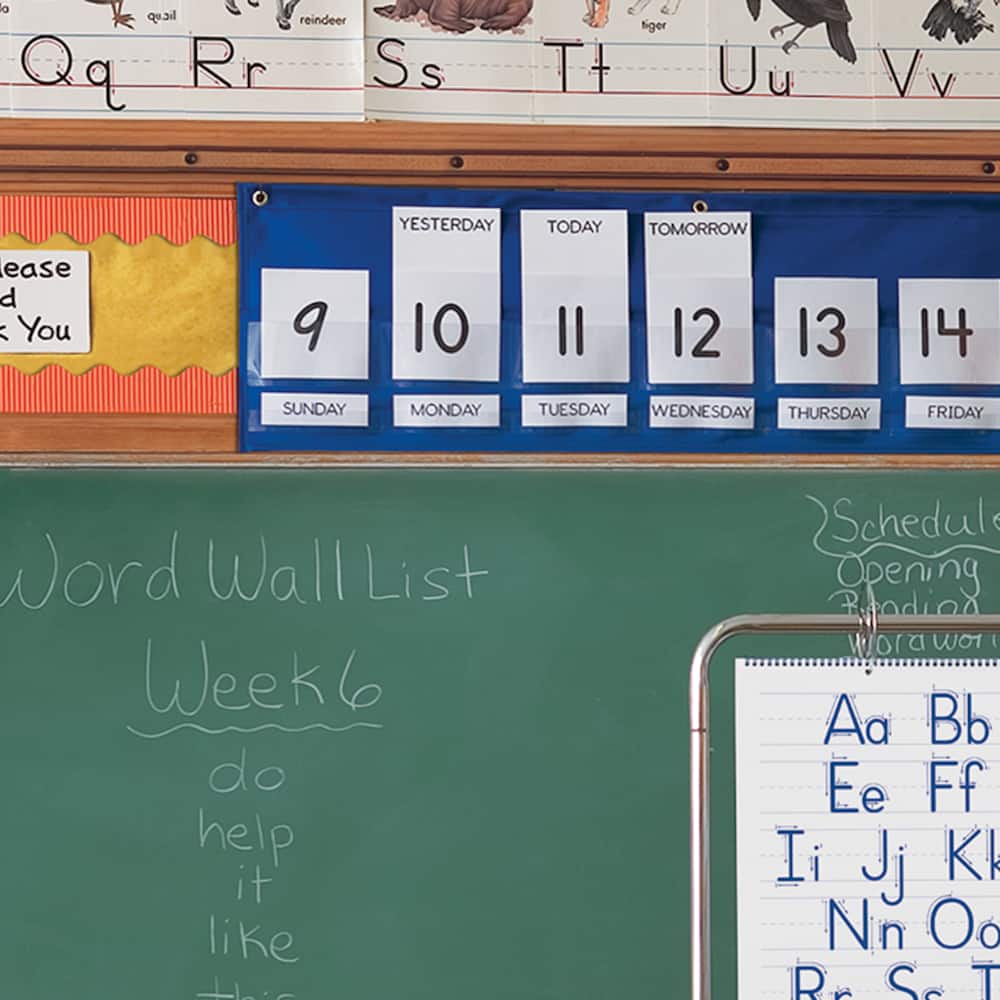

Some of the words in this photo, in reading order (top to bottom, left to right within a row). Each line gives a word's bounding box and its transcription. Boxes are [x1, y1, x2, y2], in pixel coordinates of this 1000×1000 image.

[299, 15, 347, 26] reindeer
[641, 19, 667, 33] tiger
[400, 217, 494, 233] YESTERDAY
[547, 219, 603, 234] TODAY
[649, 221, 748, 236] TOMORROW
[0, 257, 71, 279] lease
[17, 314, 71, 342] You
[293, 301, 329, 352] 9
[414, 302, 469, 354] 10
[558, 304, 585, 356] 11
[674, 307, 721, 358] 12
[800, 307, 846, 358] 13
[921, 308, 973, 357] 14
[282, 401, 346, 417] SUNDAY
[410, 402, 481, 417] MONDAY
[538, 402, 611, 417] TUESDAY
[651, 404, 751, 420] WEDNESDAY
[788, 406, 870, 421] THURSDAY
[927, 405, 984, 420] FRIDAY
[0, 530, 180, 610] Word
[207, 534, 344, 604] Wall
[366, 543, 489, 600] List
[837, 551, 980, 599] Opening
[145, 638, 325, 716] Week
[339, 649, 383, 711] 6
[823, 693, 889, 745] Aa
[929, 693, 991, 744] Bb
[208, 747, 286, 793] do
[829, 760, 886, 813] Ee
[930, 759, 984, 812] Ff
[199, 808, 294, 867] help
[236, 863, 273, 903] it
[776, 830, 820, 882] Ii
[861, 829, 904, 905] Jj
[209, 914, 299, 962] like
[829, 898, 903, 950] Nn
